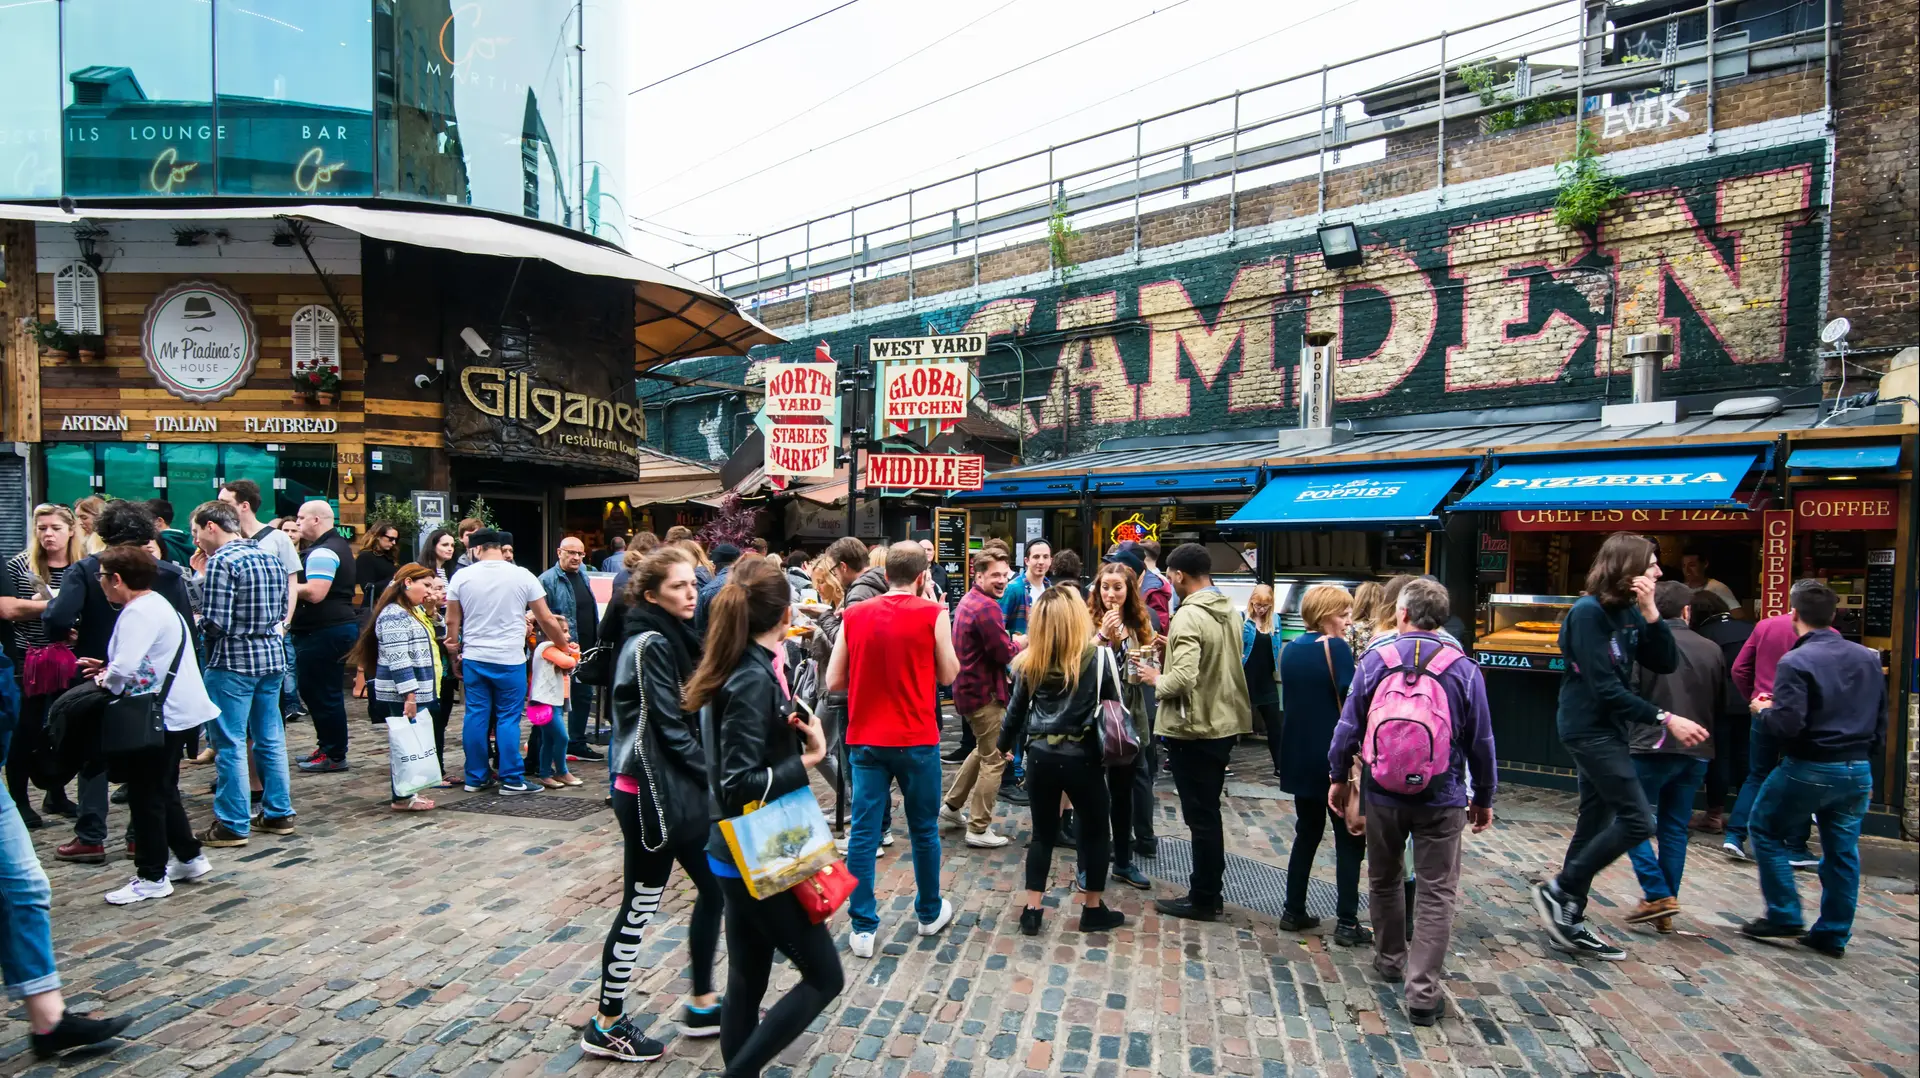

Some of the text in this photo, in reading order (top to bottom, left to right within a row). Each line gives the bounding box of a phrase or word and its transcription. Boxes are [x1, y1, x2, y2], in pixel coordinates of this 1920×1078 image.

[130, 125, 226, 140] LOUNGE
[302, 125, 347, 140] BAR
[955, 162, 1812, 437] CAMDEN
[160, 337, 241, 360] Mr Piadina's
[872, 336, 982, 358] WEST YARD
[180, 363, 219, 373] HOUSE
[769, 367, 832, 397] NORTH
[889, 367, 964, 401] GLOBAL
[1312, 351, 1322, 423] poppies
[778, 398, 822, 411] YARD
[888, 400, 963, 416] KITCHEN
[61, 415, 338, 434] ARTISAN ITALIAN FLATBREAD
[559, 430, 618, 452] restaurant
[772, 427, 828, 444] STABLES
[338, 452, 362, 464] 303
[769, 444, 830, 472] MARKET
[869, 456, 980, 487] MIDDLE YARD
[1491, 472, 1728, 490] PIZZERIA
[1295, 486, 1402, 500] POPPIE'S
[1631, 509, 1650, 523] &
[1800, 500, 1890, 517] COFFEE
[1480, 532, 1508, 551] Pizza
[1869, 551, 1892, 563] COFFEE
[1478, 652, 1531, 668] PIZZA
[620, 881, 665, 940] JUST
[607, 940, 642, 980] DO
